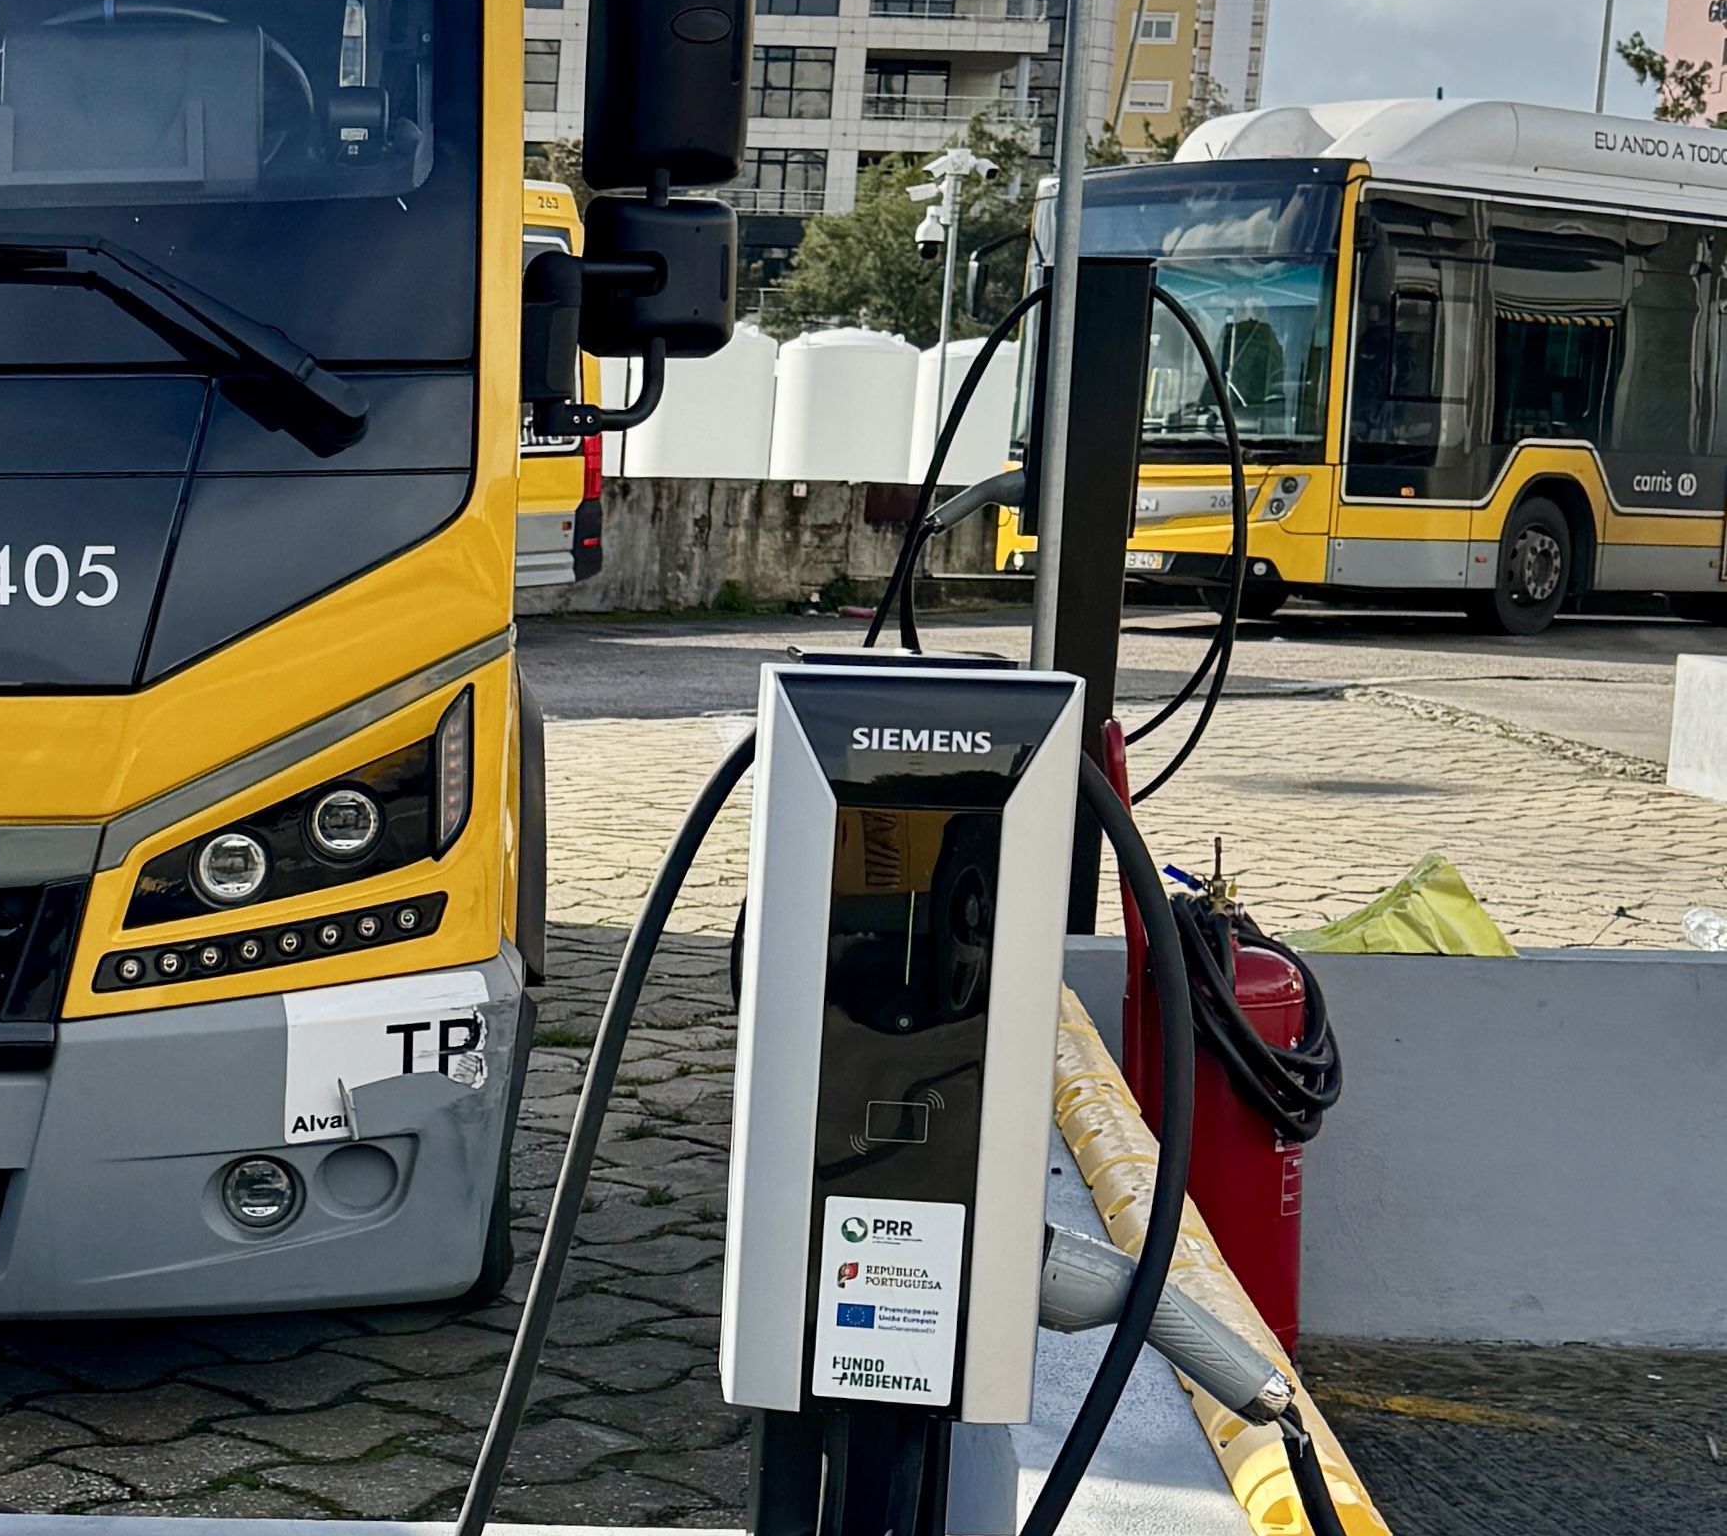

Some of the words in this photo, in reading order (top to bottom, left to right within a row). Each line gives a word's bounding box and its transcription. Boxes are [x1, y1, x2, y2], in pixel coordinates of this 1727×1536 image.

[1594, 130, 1617, 151] EU
[1619, 134, 1669, 158] ANDO
[1672, 142, 1685, 160] A
[537, 196, 559, 209] 263
[1633, 470, 1673, 493] carris
[852, 727, 992, 754] SIEMENS
[872, 1219, 913, 1236] PRR
[865, 1276, 942, 1290] PORTUGUESA
[832, 1356, 885, 1373] FUNDO
[831, 1371, 932, 1392] AMBIENTAL
